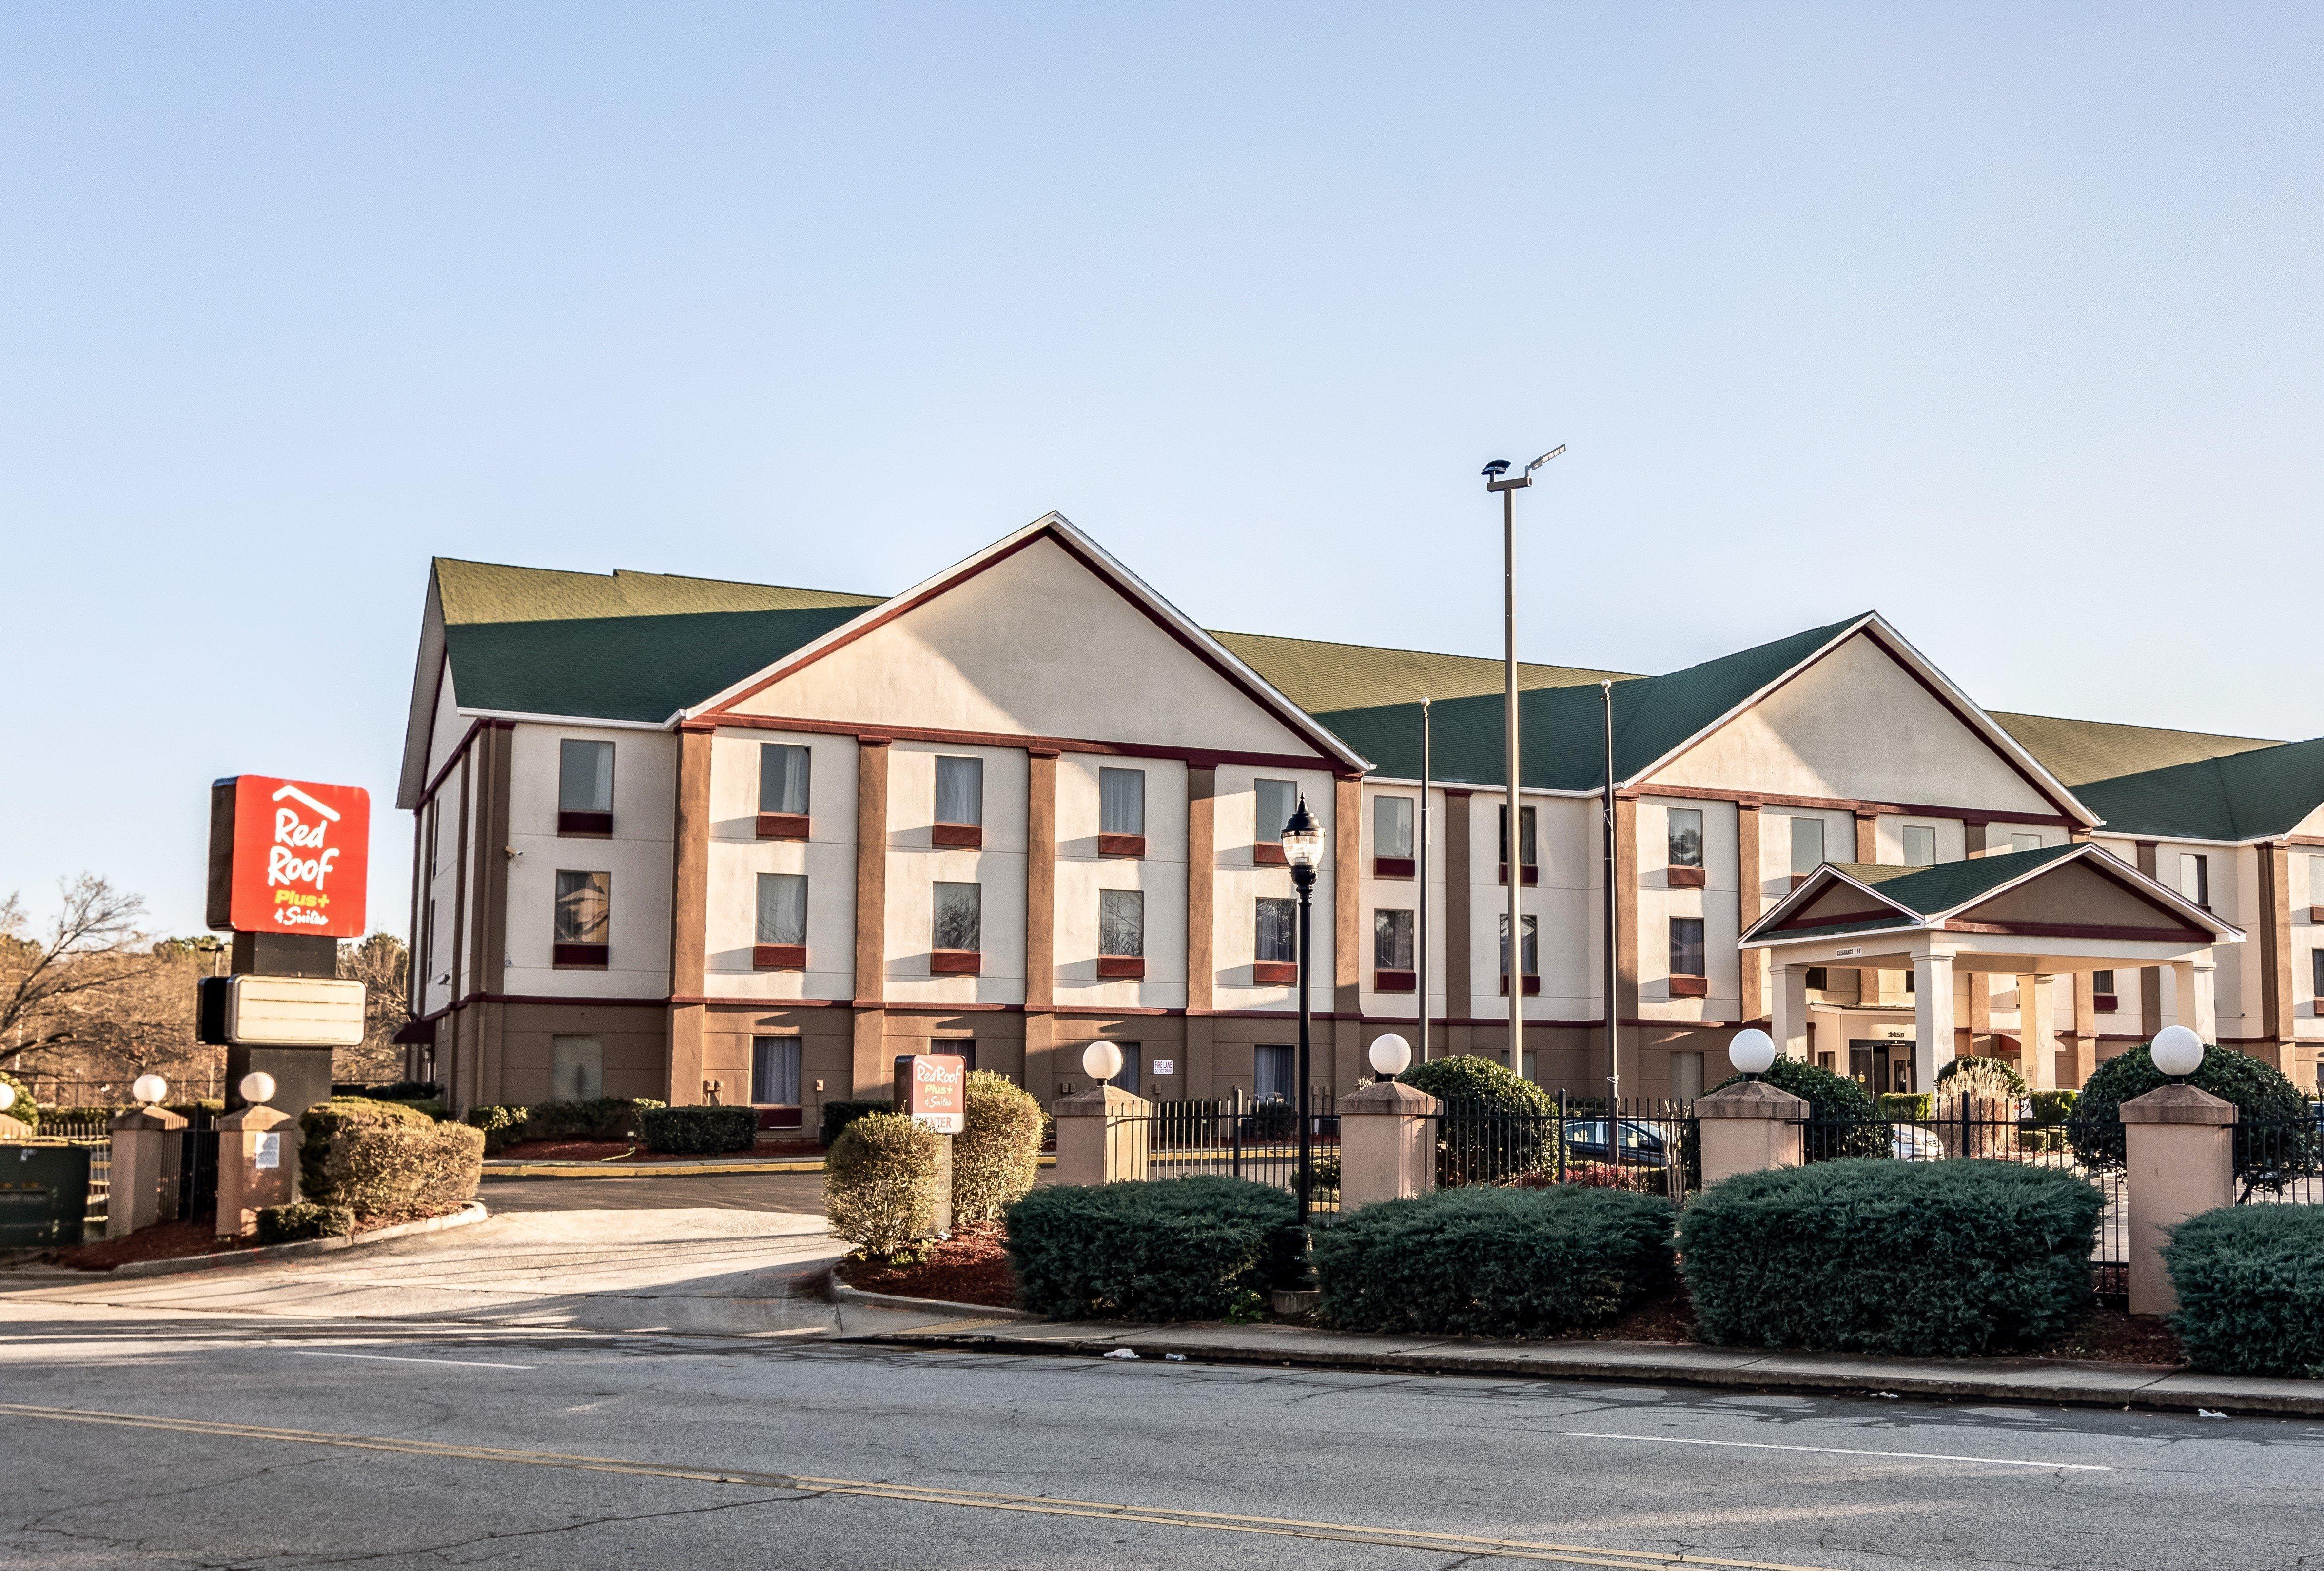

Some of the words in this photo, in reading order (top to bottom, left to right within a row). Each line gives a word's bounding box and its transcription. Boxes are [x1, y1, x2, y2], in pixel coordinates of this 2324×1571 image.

[275, 808, 327, 848] Red
[268, 845, 340, 891] Roof
[274, 890, 330, 908] Plus+
[283, 906, 329, 925] Suites
[917, 1065, 937, 1083] Red
[937, 1064, 963, 1085] Roof
[924, 1084, 954, 1095] Plus+
[929, 1095, 953, 1108] Suites
[925, 1117, 951, 1128] ENTER
